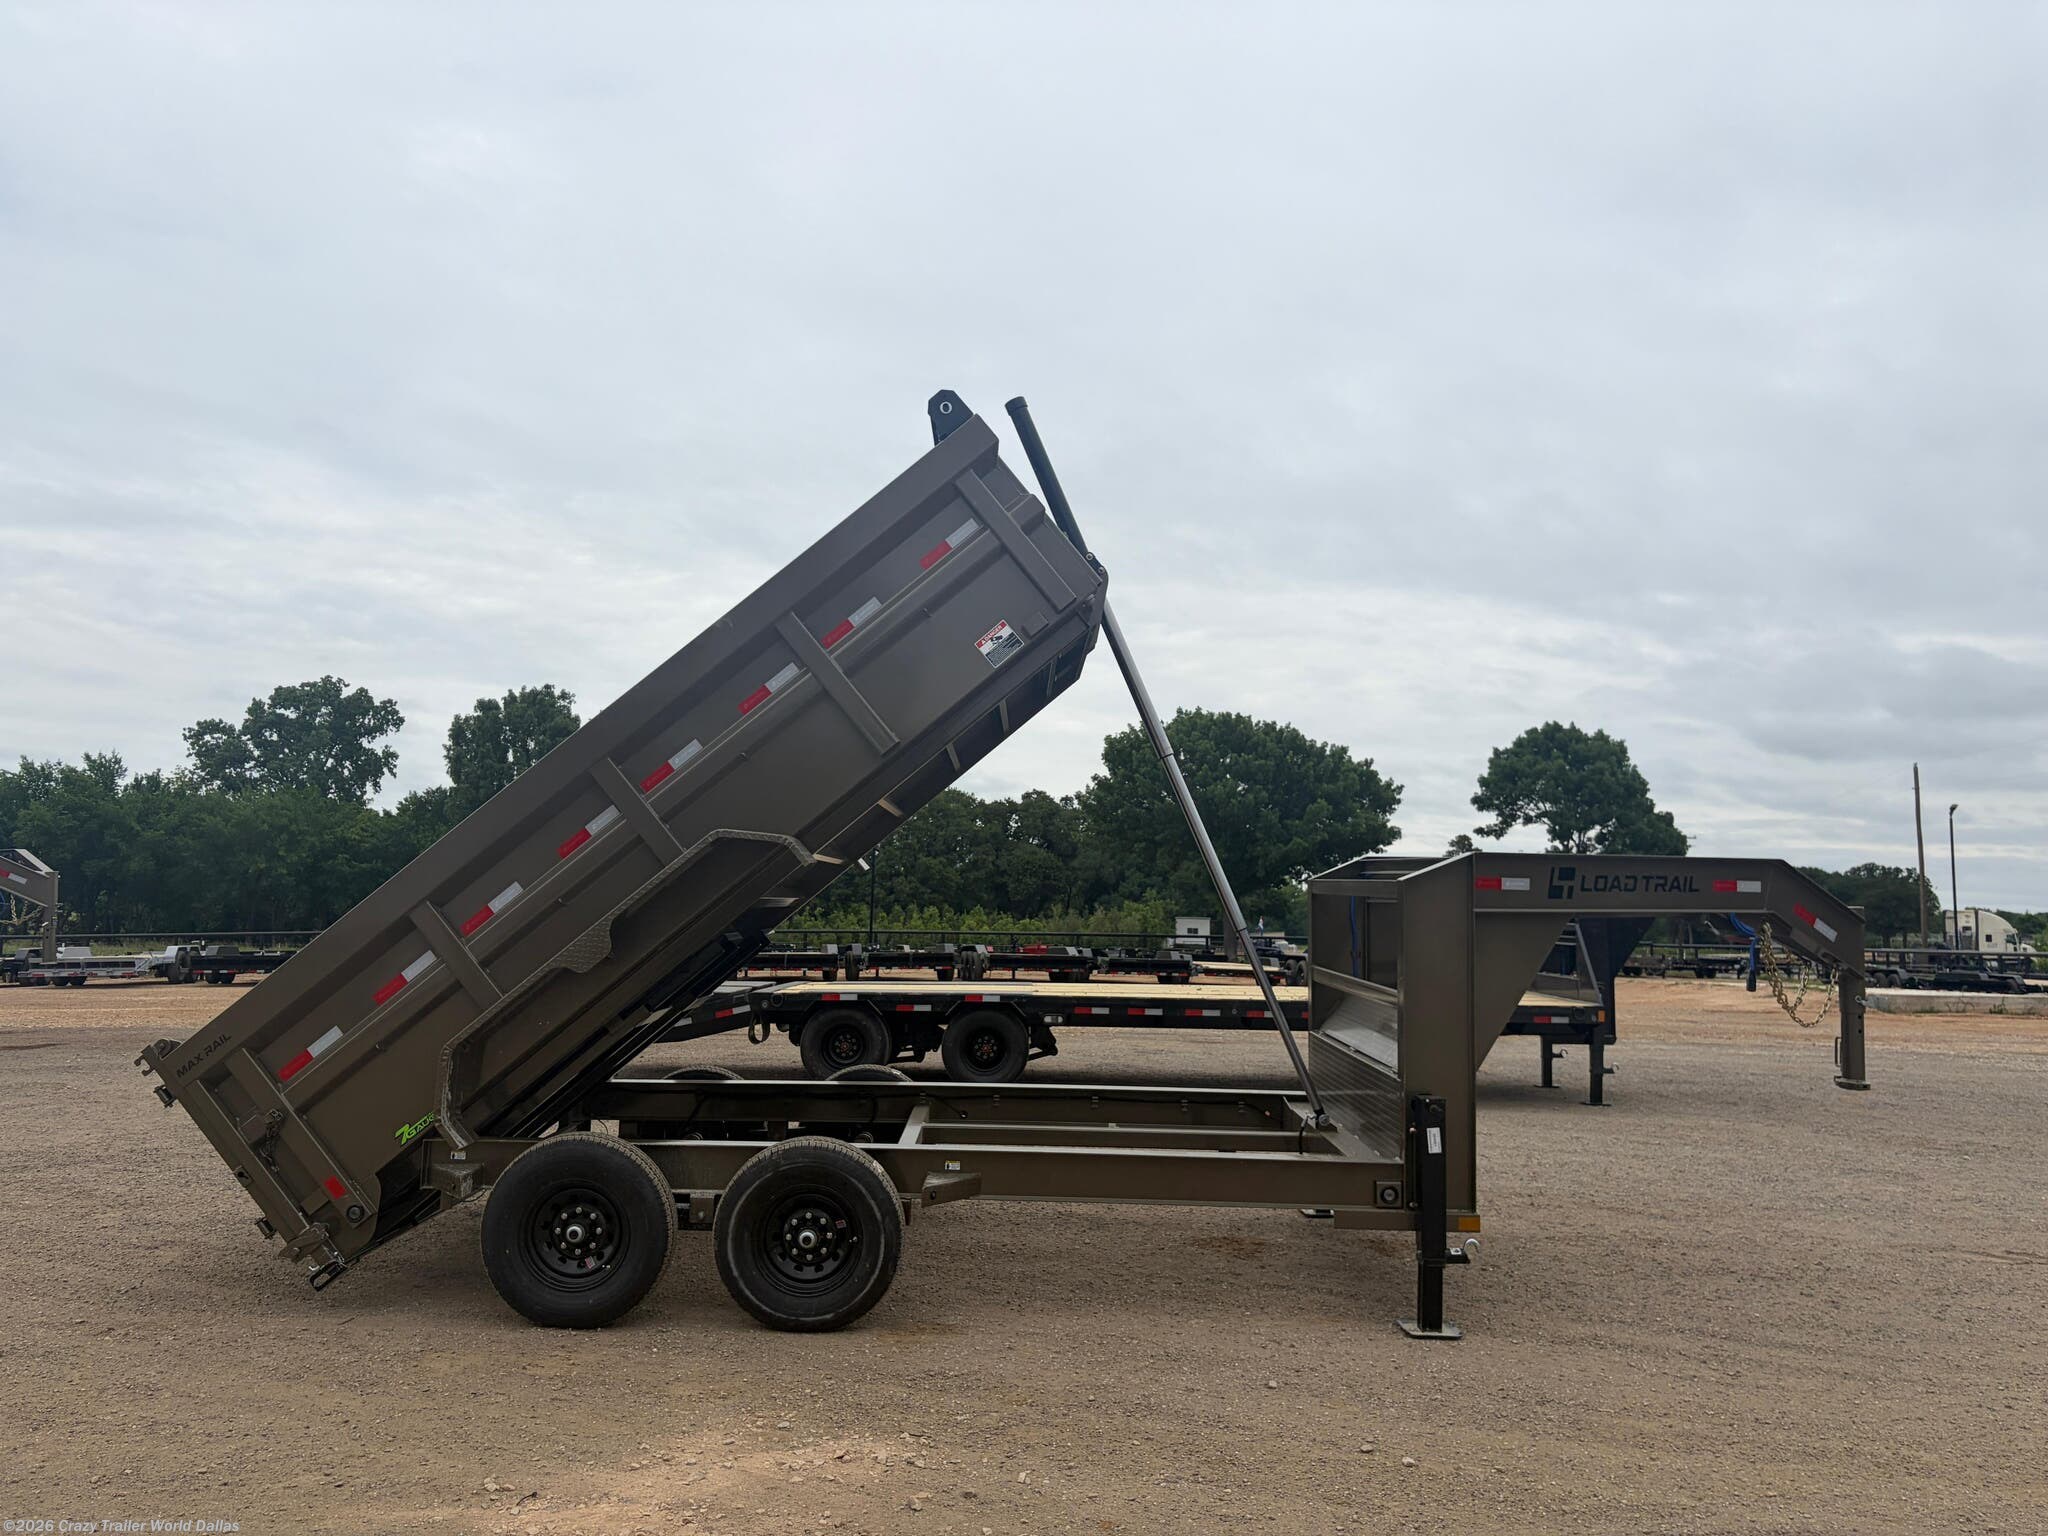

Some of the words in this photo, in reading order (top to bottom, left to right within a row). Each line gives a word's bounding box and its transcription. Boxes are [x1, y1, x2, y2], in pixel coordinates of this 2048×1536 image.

[985, 624, 1003, 641] DANGER
[176, 1053, 204, 1078] MAX
[203, 1034, 232, 1057] RAIL
